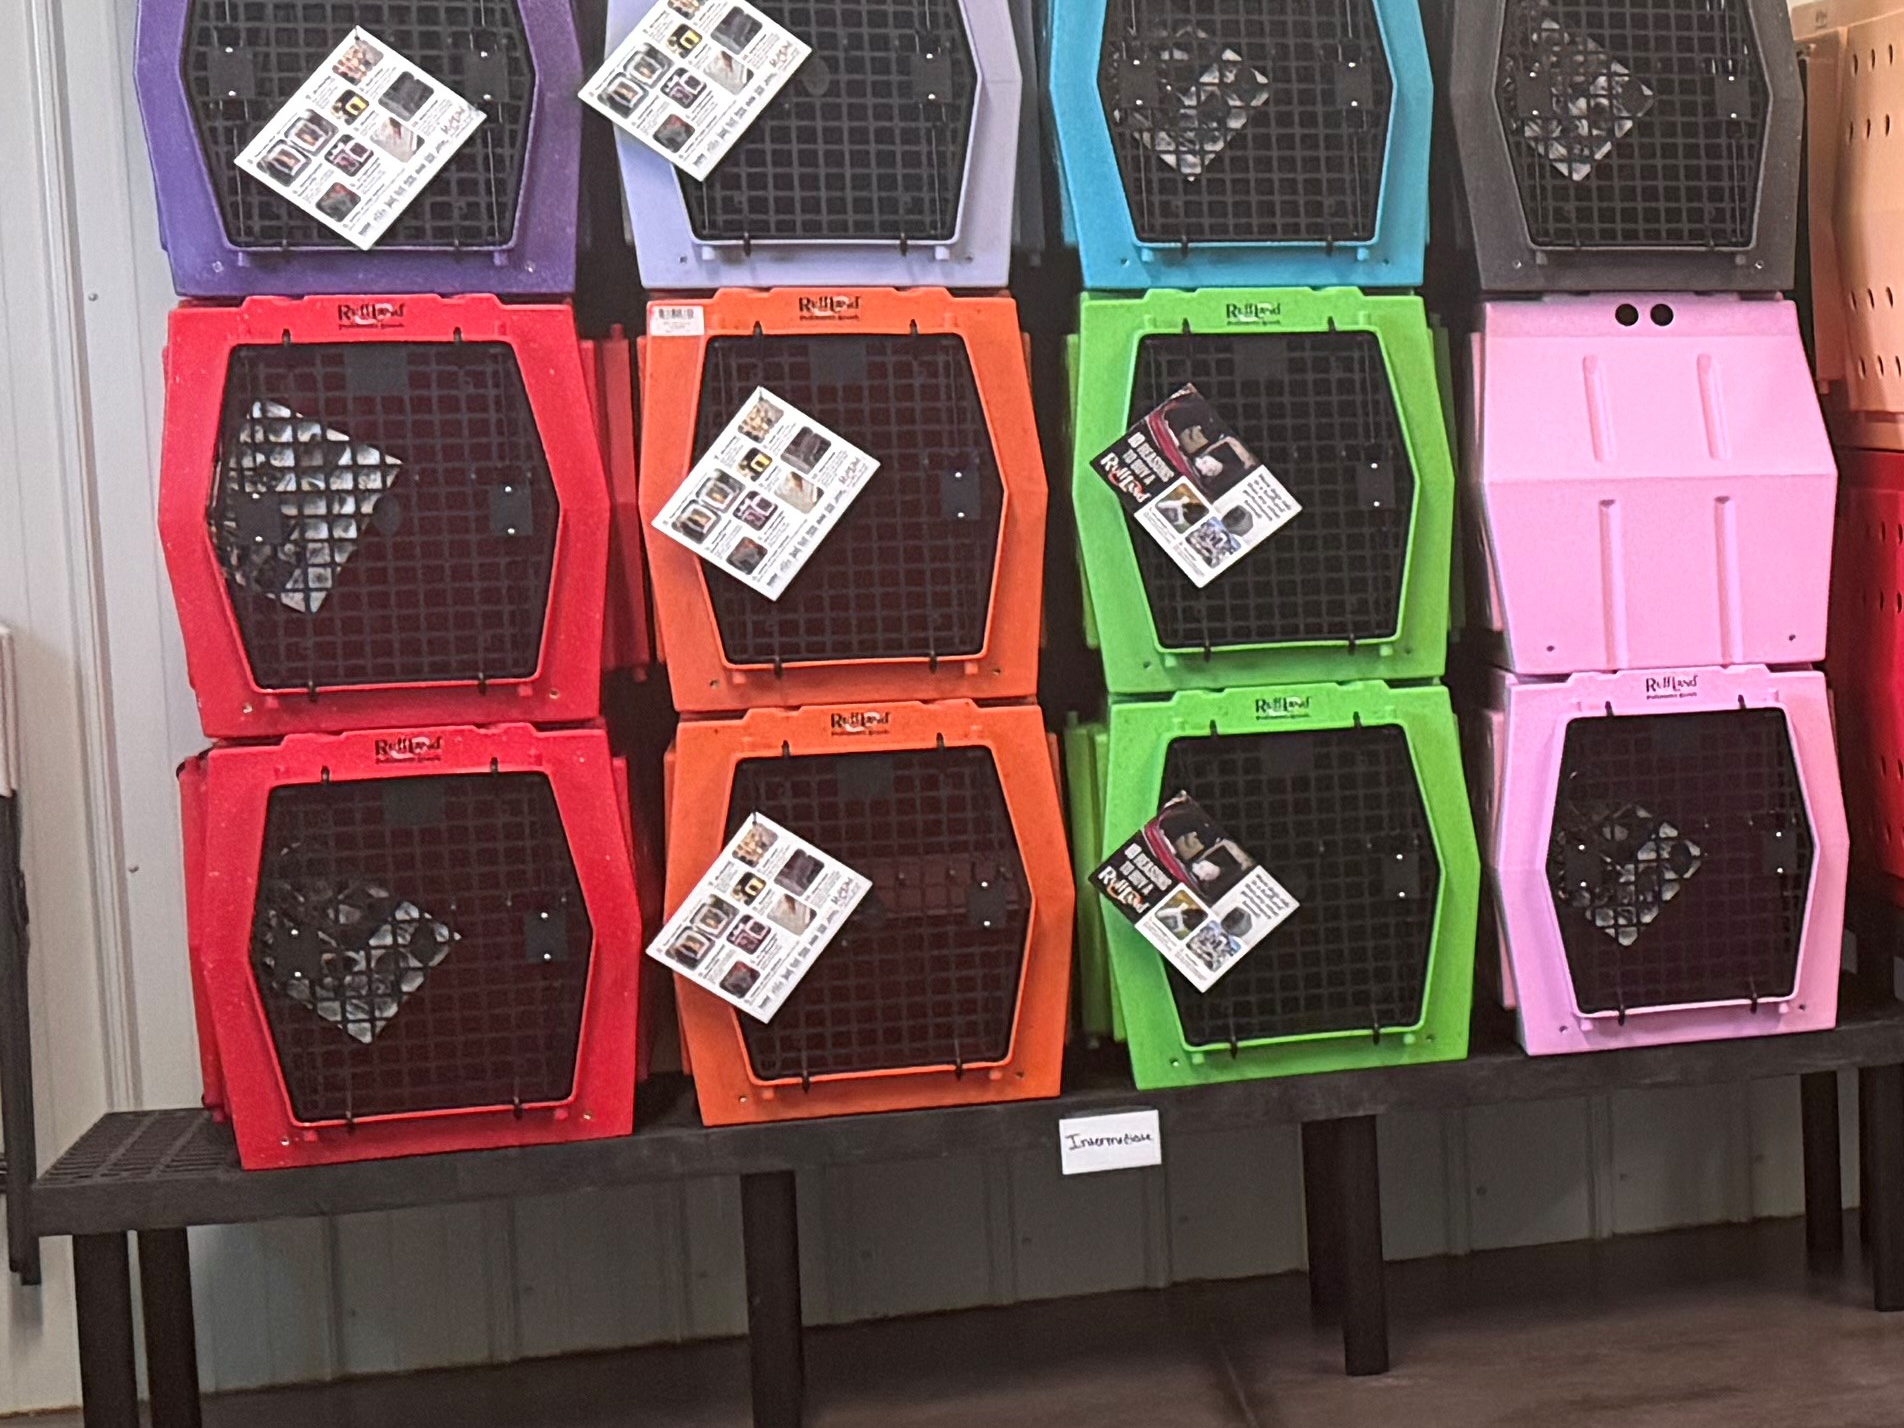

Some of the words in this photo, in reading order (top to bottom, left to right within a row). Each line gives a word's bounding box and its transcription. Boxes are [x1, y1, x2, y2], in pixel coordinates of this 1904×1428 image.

[1120, 448, 1138, 464] TO
[1129, 457, 1151, 479] BUY
[1142, 473, 1156, 485] A
[1135, 441, 1175, 483] REASONS
[1140, 882, 1155, 896] A
